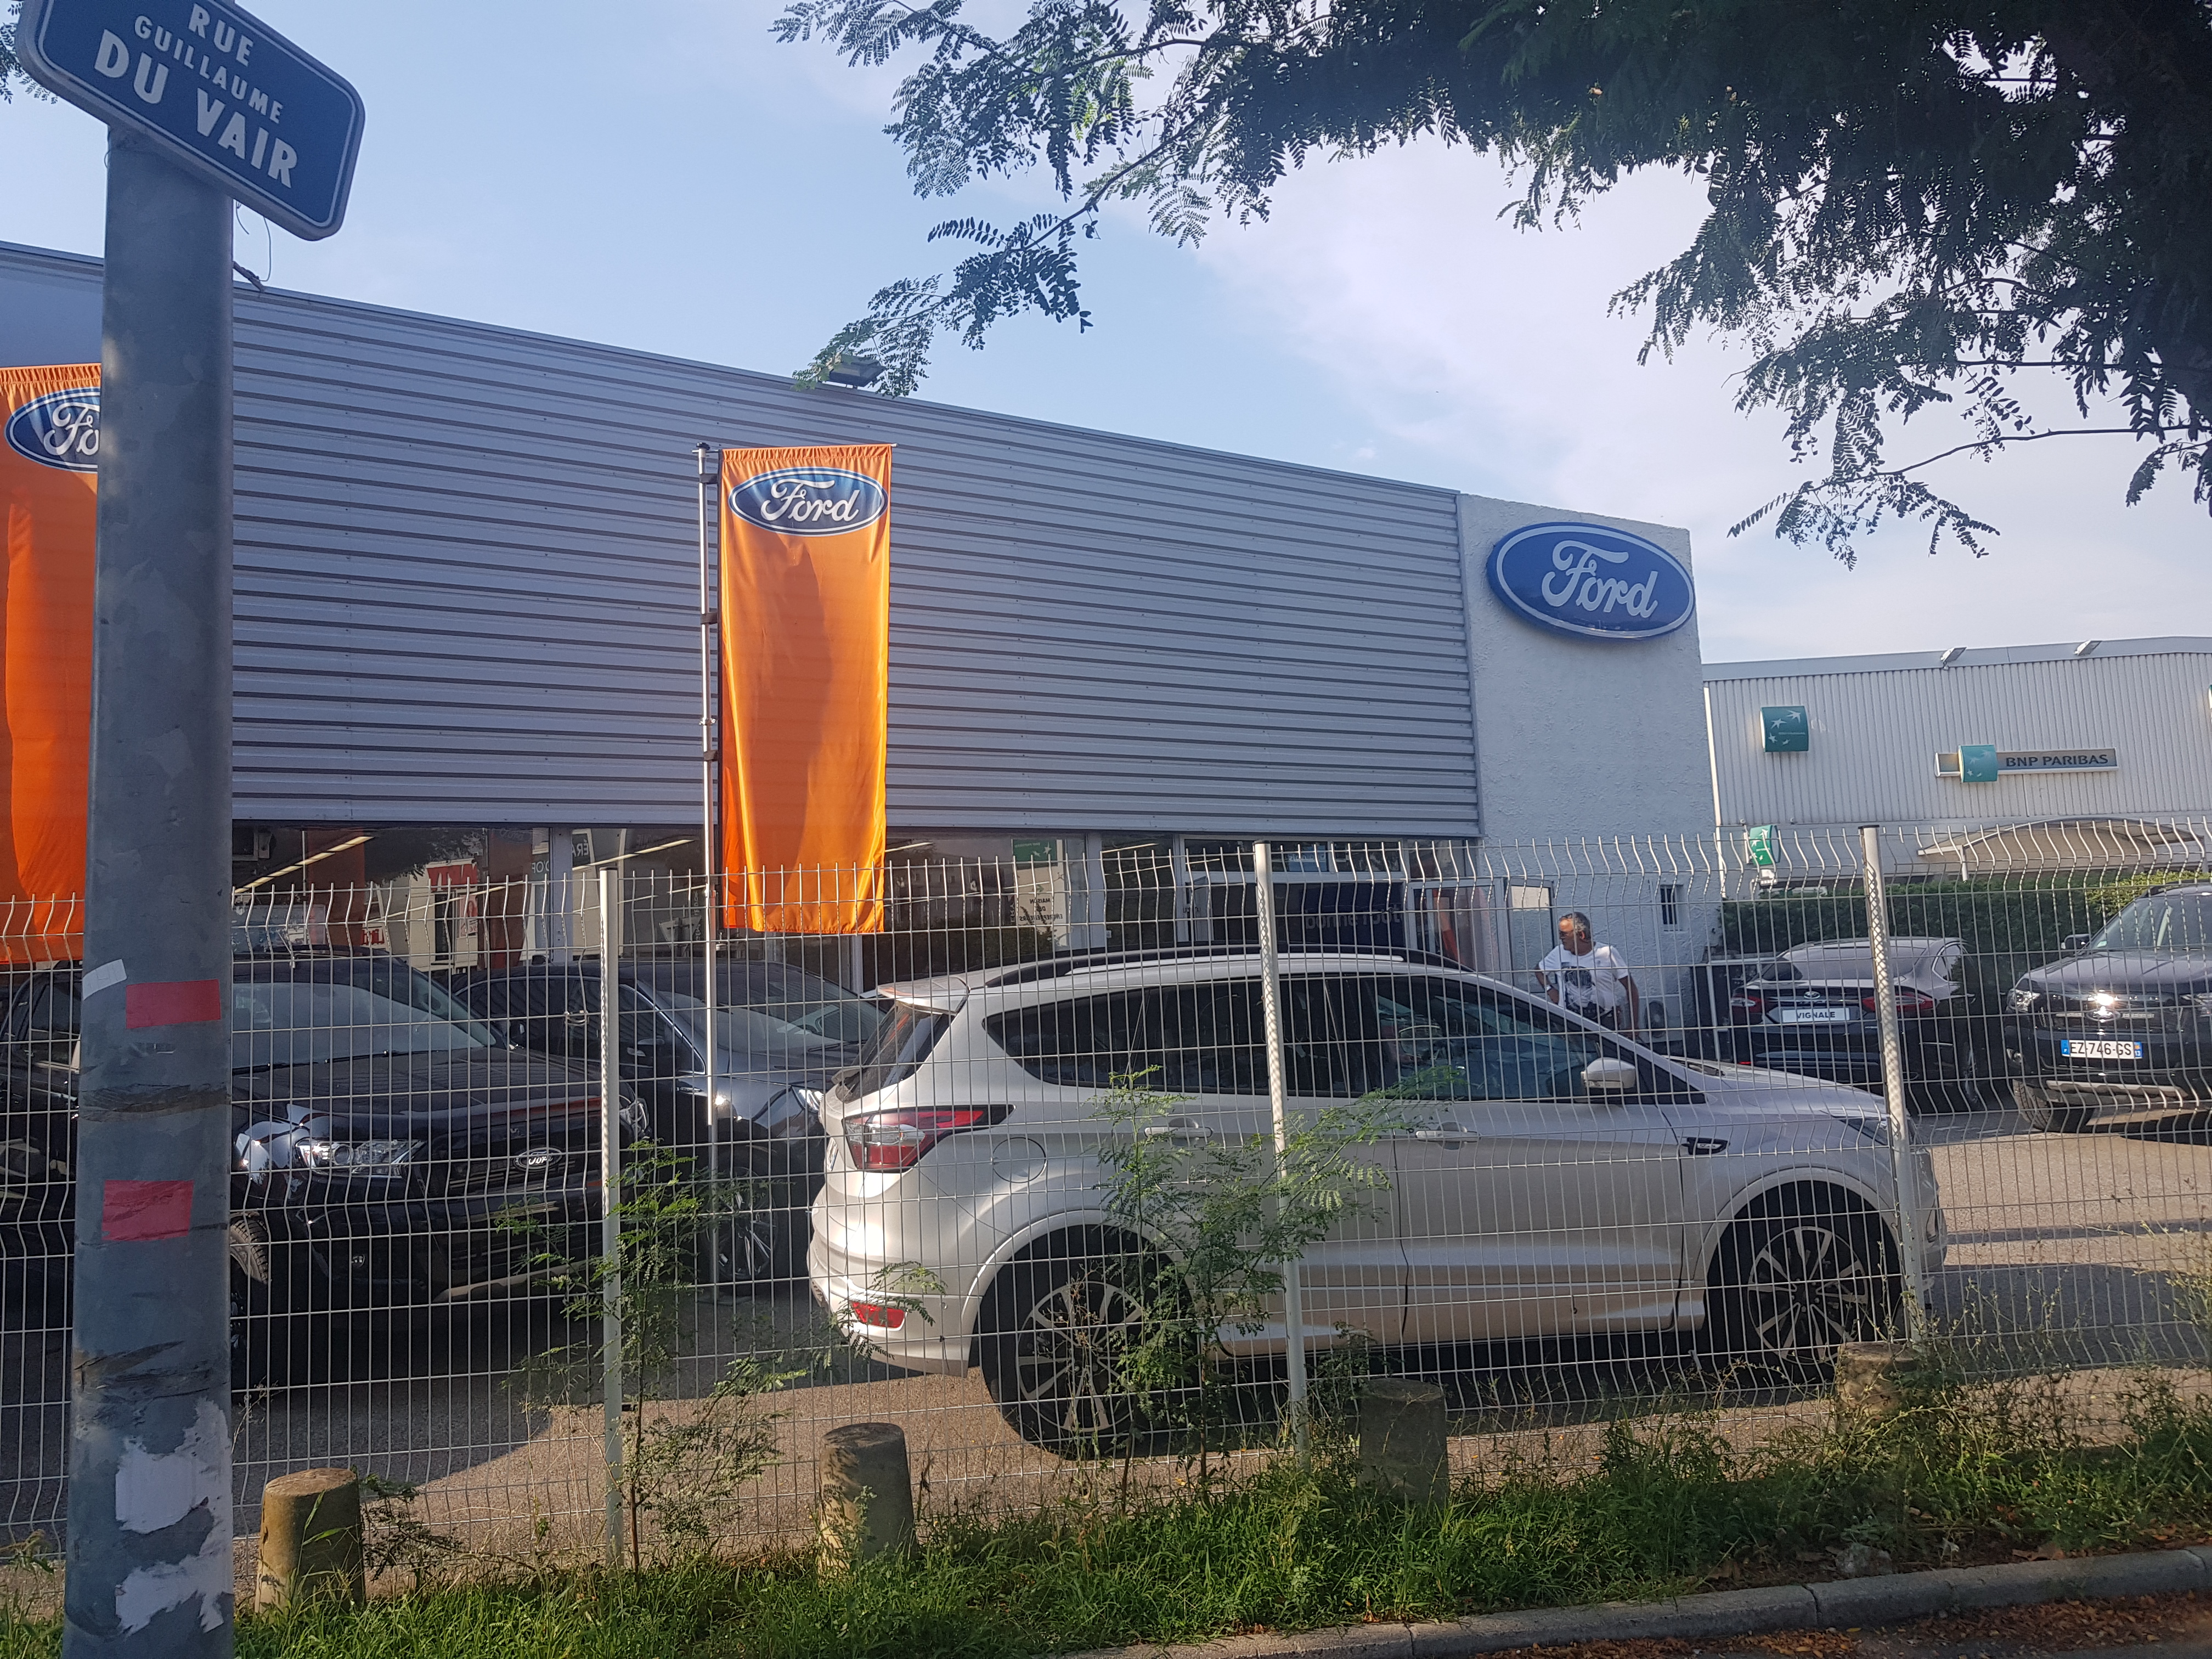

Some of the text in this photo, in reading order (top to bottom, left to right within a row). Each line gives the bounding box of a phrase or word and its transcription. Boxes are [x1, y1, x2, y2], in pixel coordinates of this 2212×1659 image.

[188, 2, 254, 67] RUE
[134, 15, 284, 124] GUILLAUME
[94, 29, 298, 188] DU VAIR
[43, 402, 100, 455] Fo
[760, 478, 860, 521] Ford
[1542, 540, 1658, 618] Ford
[2006, 754, 2108, 766] BNP PARIBAS
[2070, 1042, 2132, 1056] EZ-746-GS
